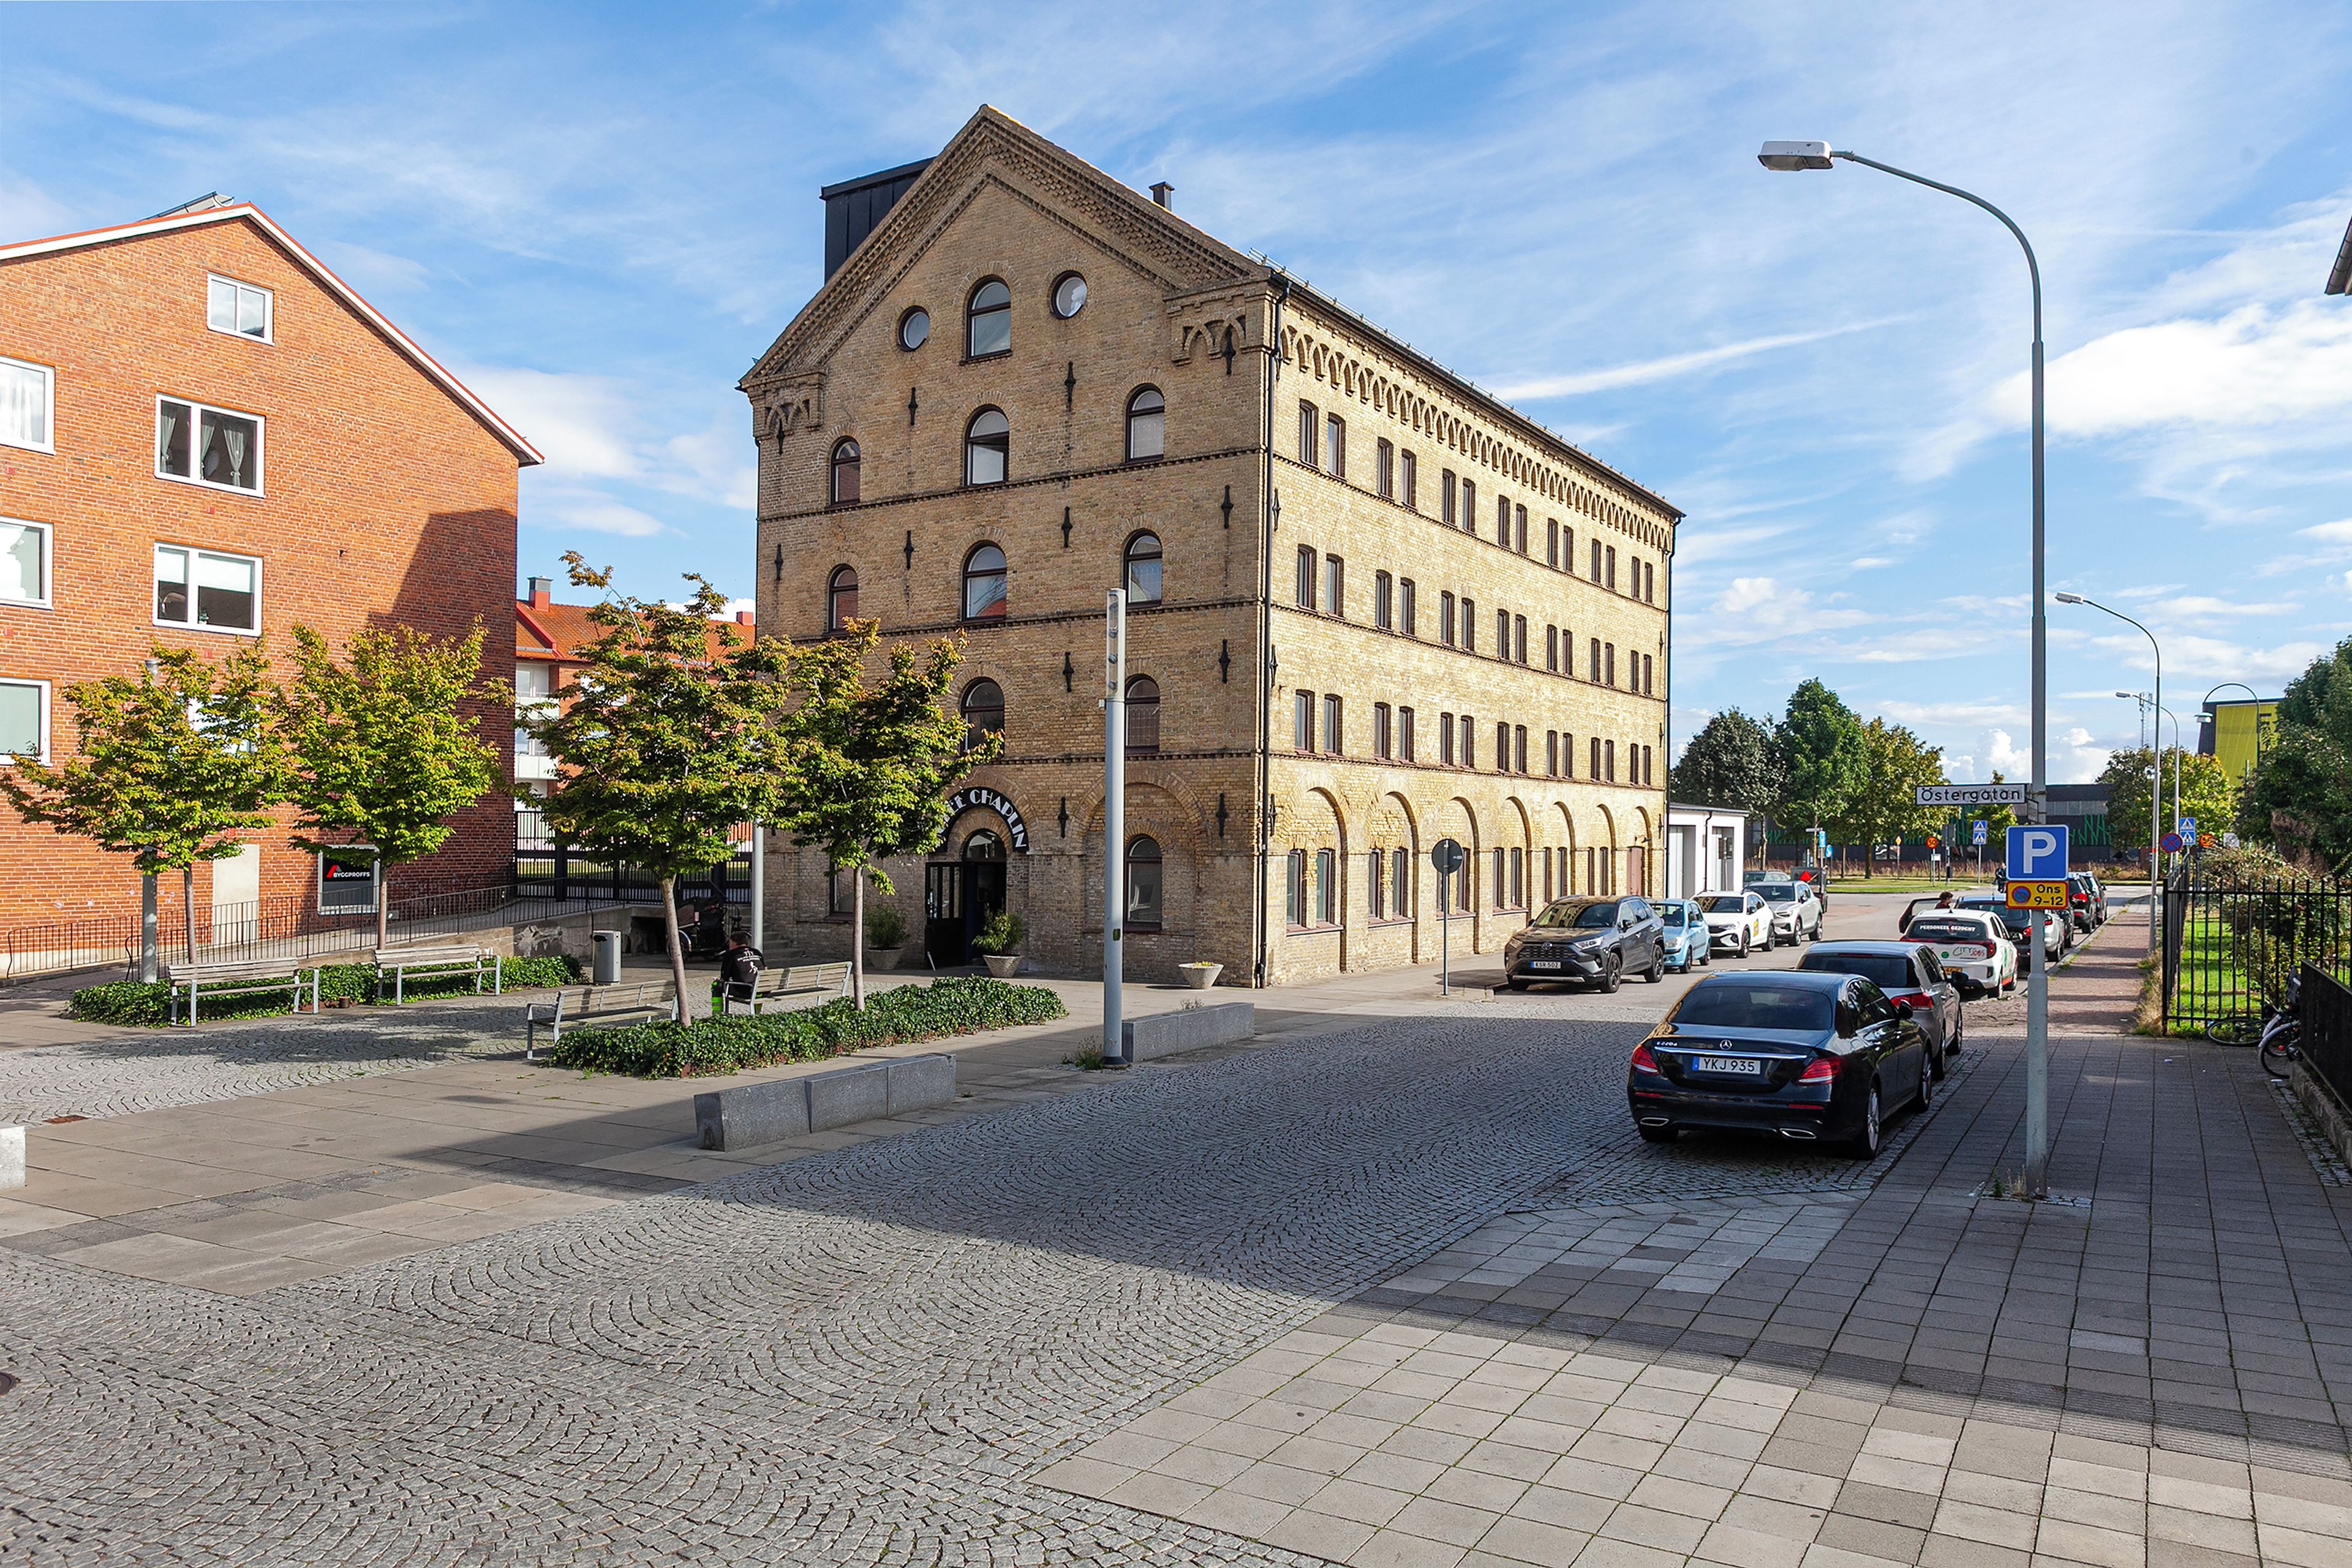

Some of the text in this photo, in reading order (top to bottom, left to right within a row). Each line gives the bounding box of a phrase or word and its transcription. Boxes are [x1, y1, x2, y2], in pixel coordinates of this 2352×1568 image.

[1921, 787, 2020, 802] Östergatan
[970, 789, 1027, 848] CHAPLIN
[2024, 831, 2056, 873] P
[2037, 884, 2060, 893] Ons
[2034, 896, 2063, 905] 9-12
[1703, 1058, 1755, 1072] YKJ 935
